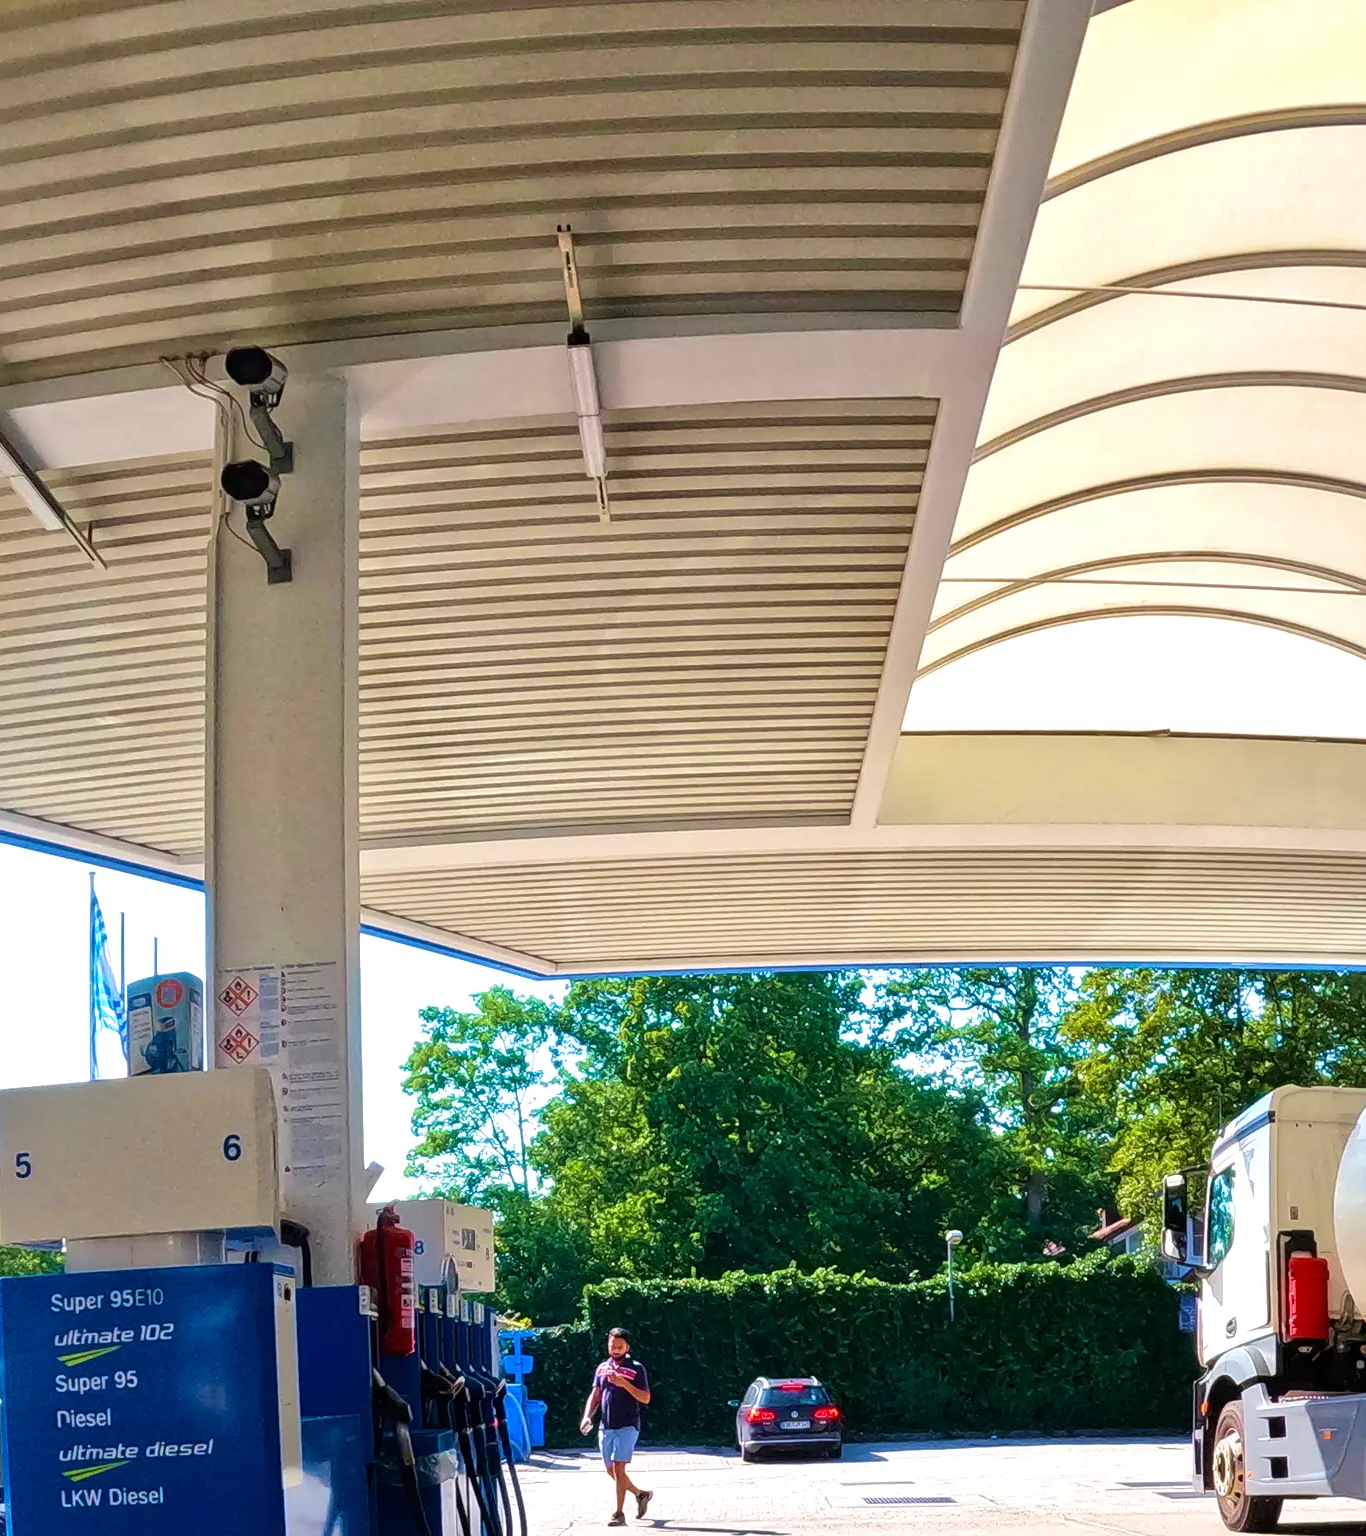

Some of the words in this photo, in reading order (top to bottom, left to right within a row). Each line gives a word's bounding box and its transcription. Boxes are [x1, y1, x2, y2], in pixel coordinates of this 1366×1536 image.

[223, 1134, 242, 1161] 6
[14, 1152, 32, 1179] 5
[414, 1240, 425, 1255] 8
[51, 1293, 105, 1314] Super
[54, 1328, 134, 1346] ultimate
[140, 1323, 174, 1342] 102
[55, 1375, 108, 1394] Super
[114, 1371, 138, 1389] 95
[57, 1408, 112, 1428] Diesel
[59, 1442, 138, 1461] ultimate
[146, 1438, 214, 1458] diesel
[61, 1489, 102, 1508] LKW
[109, 1486, 164, 1506] Diesel
